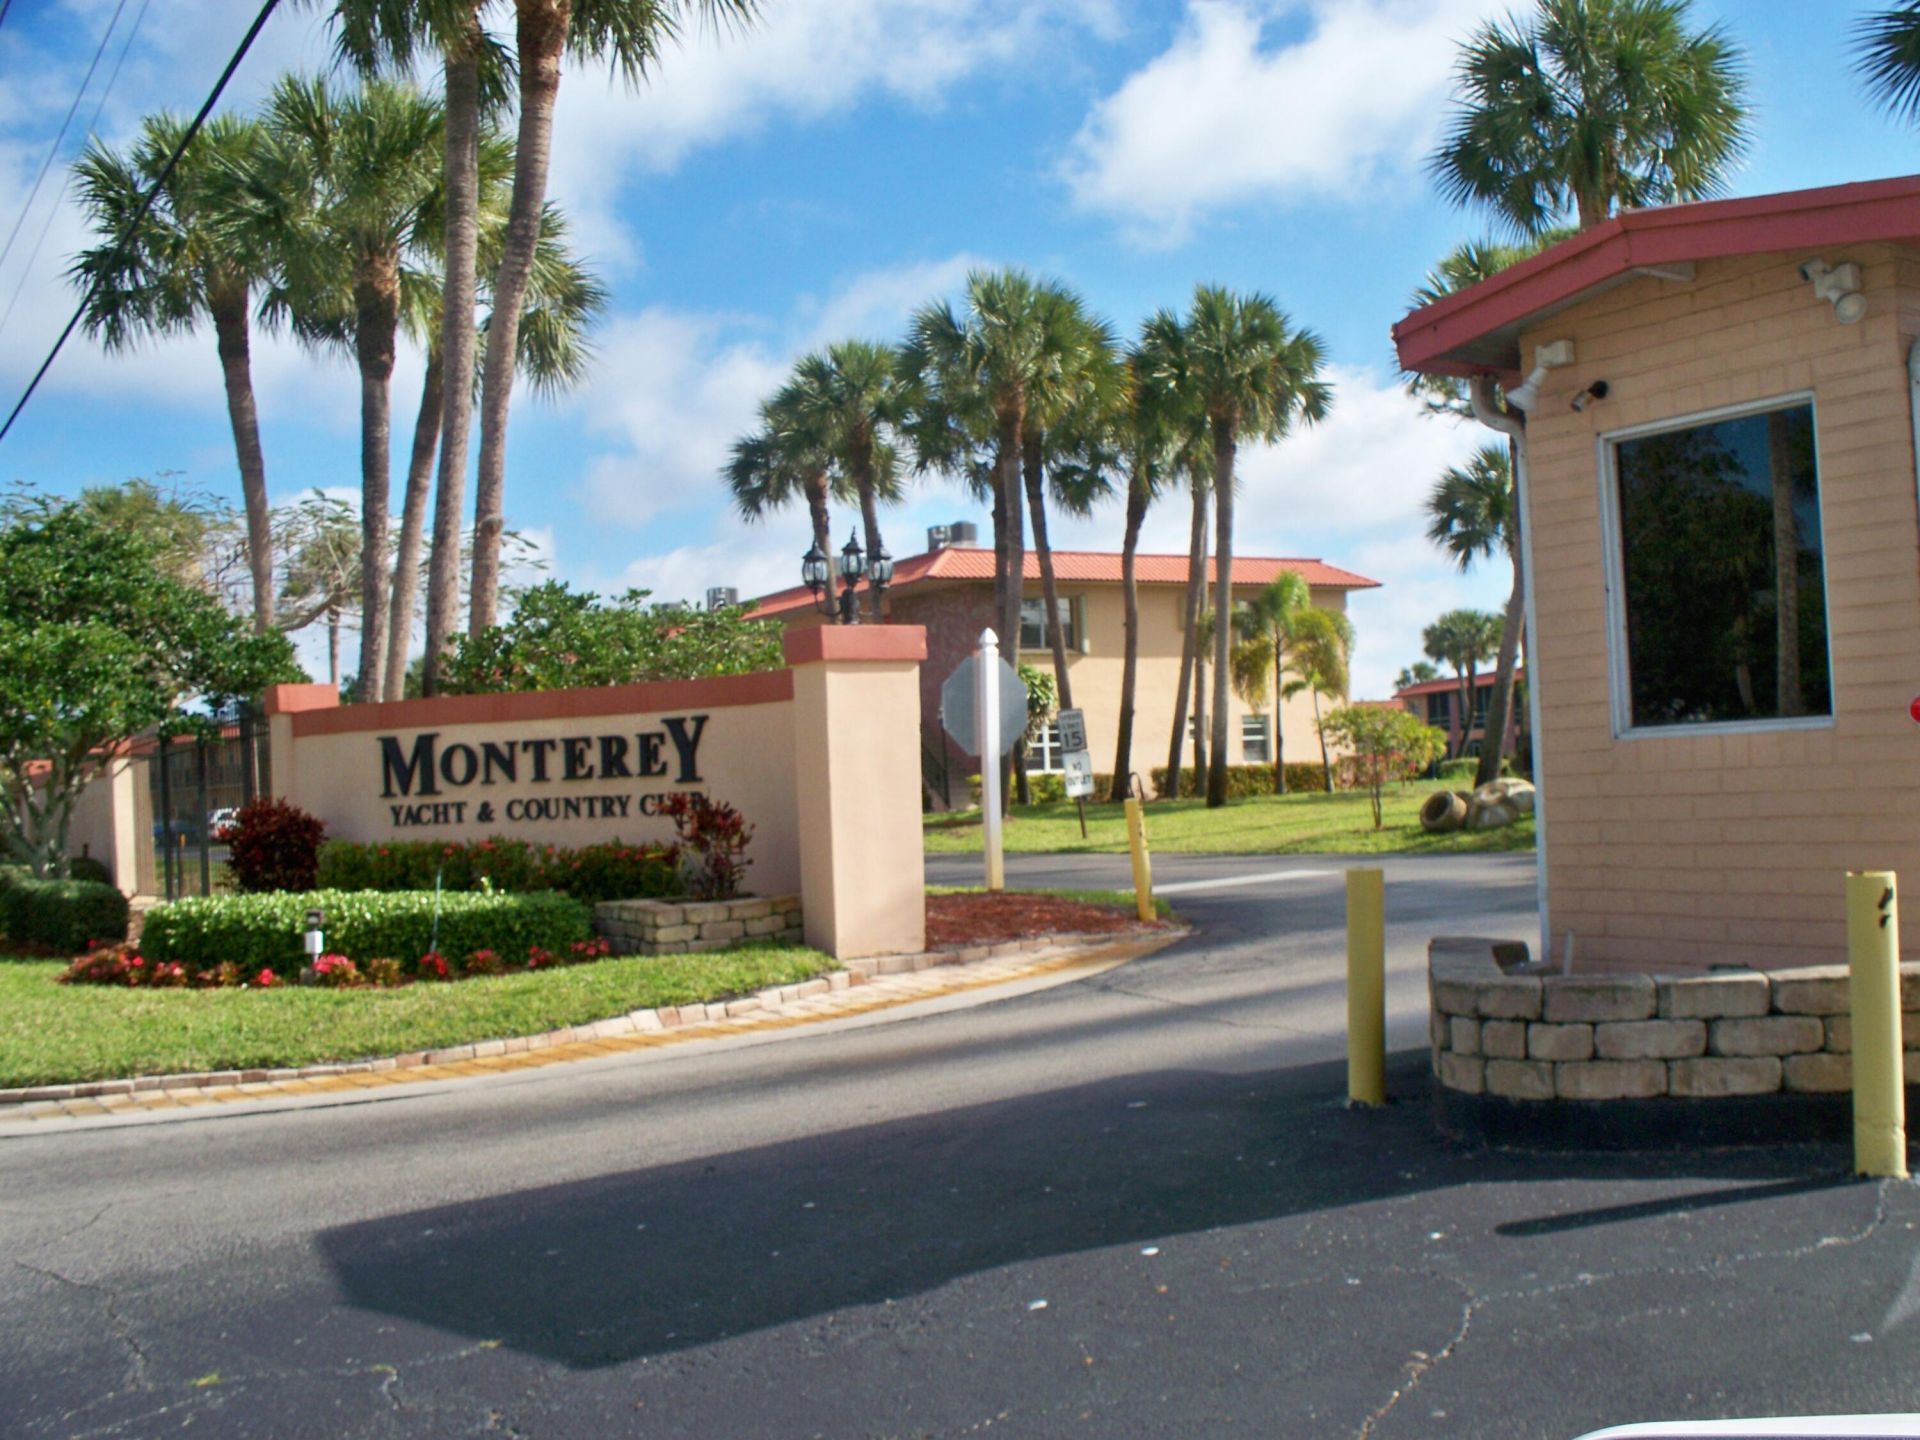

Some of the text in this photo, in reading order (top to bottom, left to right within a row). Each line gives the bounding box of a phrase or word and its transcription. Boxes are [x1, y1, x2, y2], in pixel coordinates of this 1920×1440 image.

[1063, 730, 1083, 748] 15
[390, 791, 706, 826] YACHT & COUNTRY CLB
